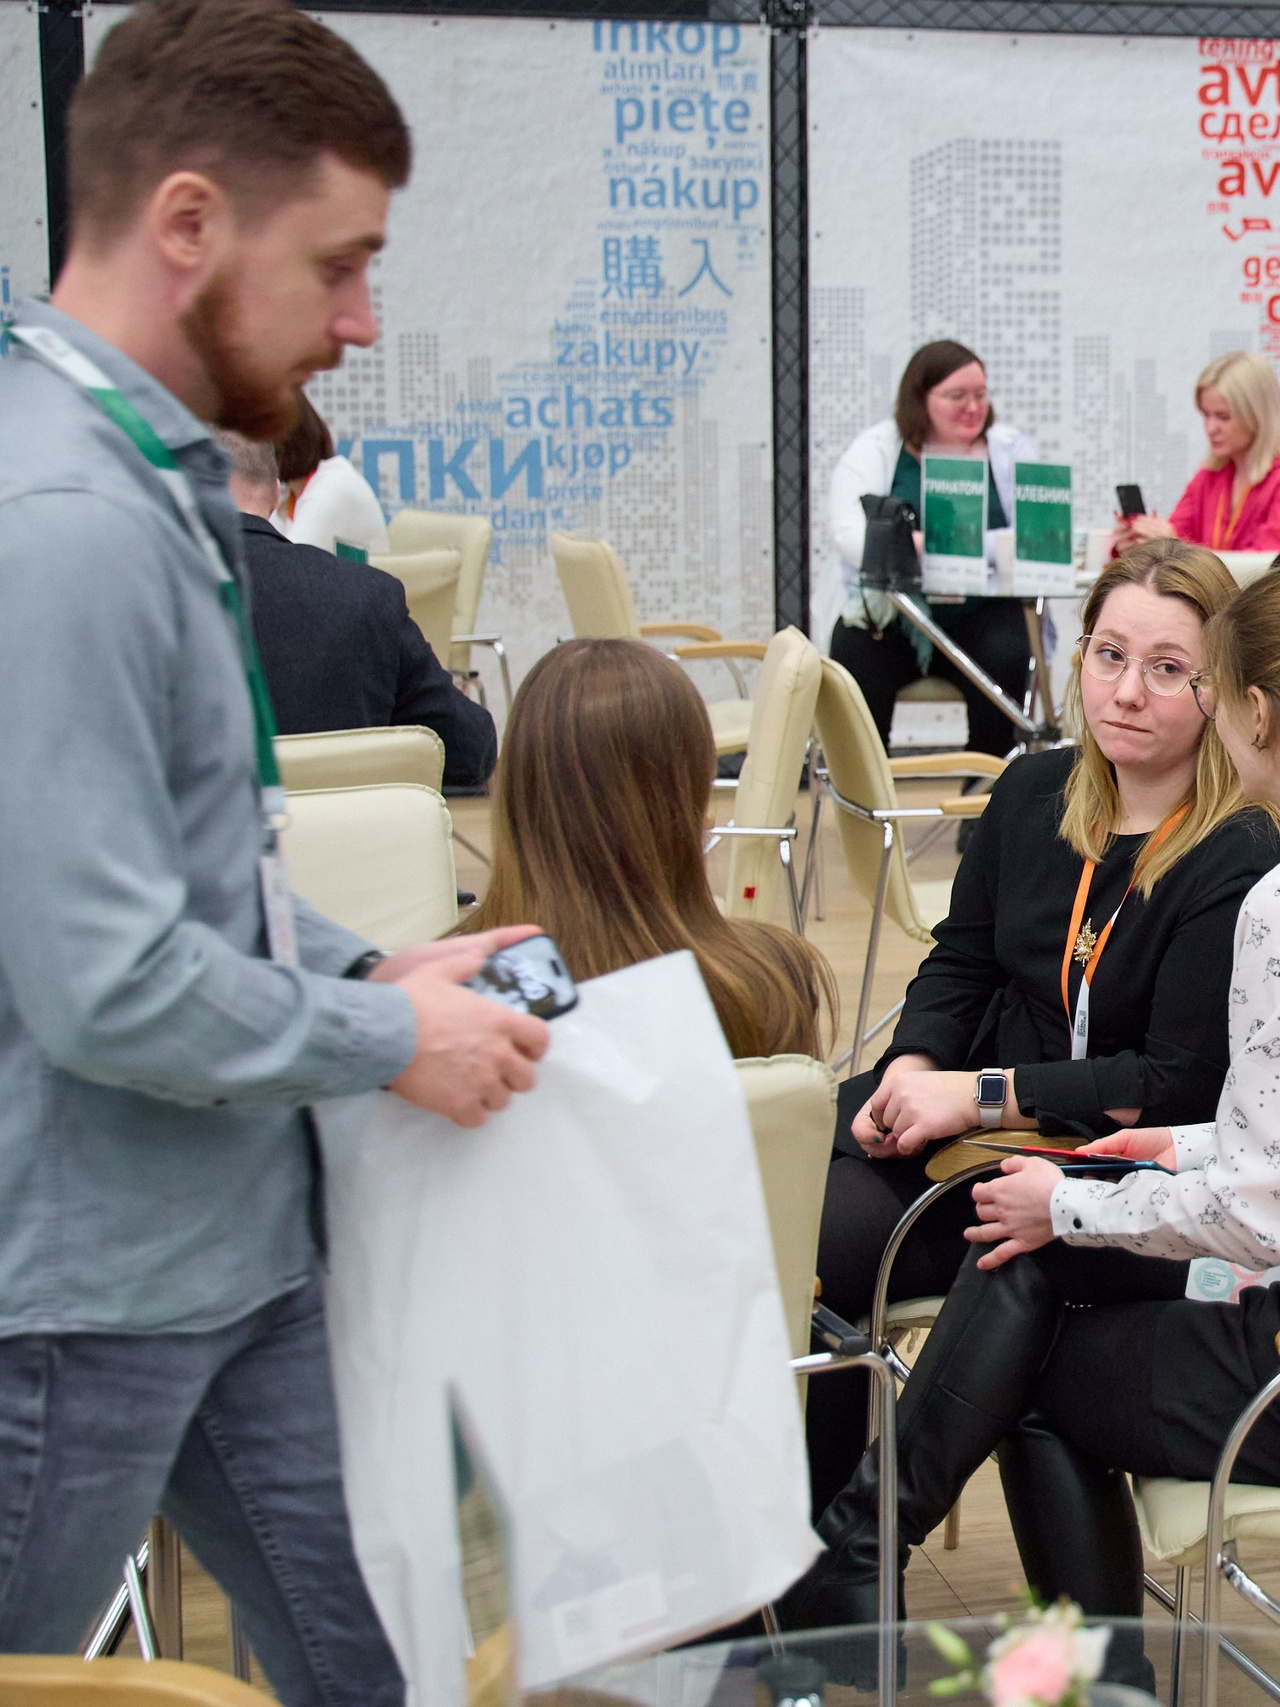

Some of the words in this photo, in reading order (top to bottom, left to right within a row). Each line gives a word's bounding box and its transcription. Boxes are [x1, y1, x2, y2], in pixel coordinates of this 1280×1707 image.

[610, 164, 759, 221] nákup
[555, 328, 700, 375] zakupy
[505, 384, 674, 428] achats
[547, 432, 632, 478] kjøp
